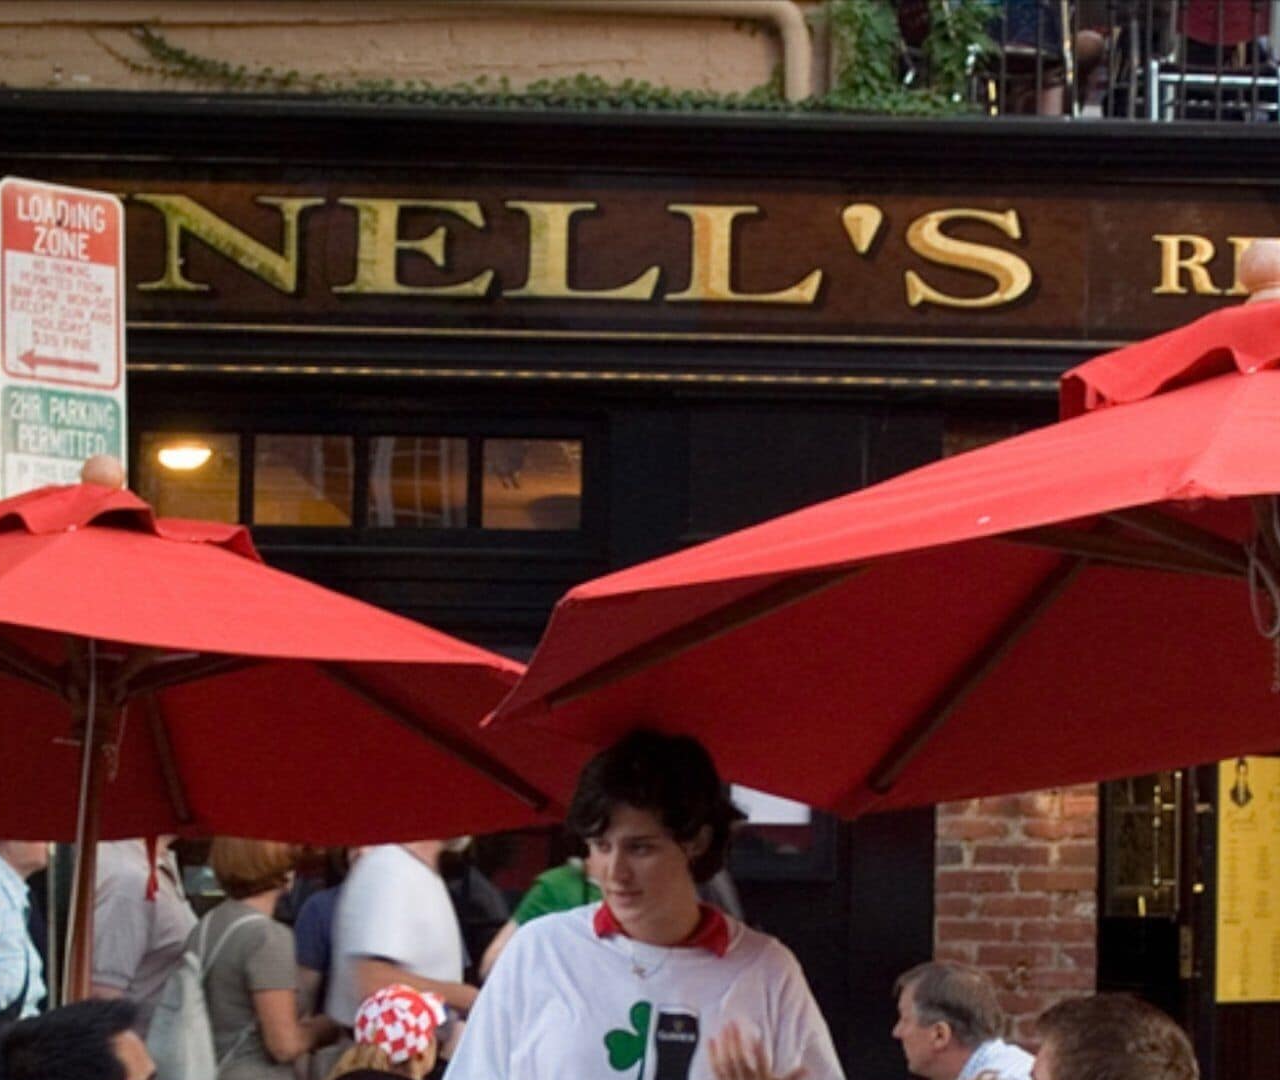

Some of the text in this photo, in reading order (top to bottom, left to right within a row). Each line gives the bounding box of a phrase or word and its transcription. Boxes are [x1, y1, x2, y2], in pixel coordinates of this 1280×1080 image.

[16, 194, 106, 234] LOADING
[33, 225, 90, 261] ZONE
[10, 391, 115, 432] 2HR PARKING
[19, 423, 106, 458] PERMITTED
